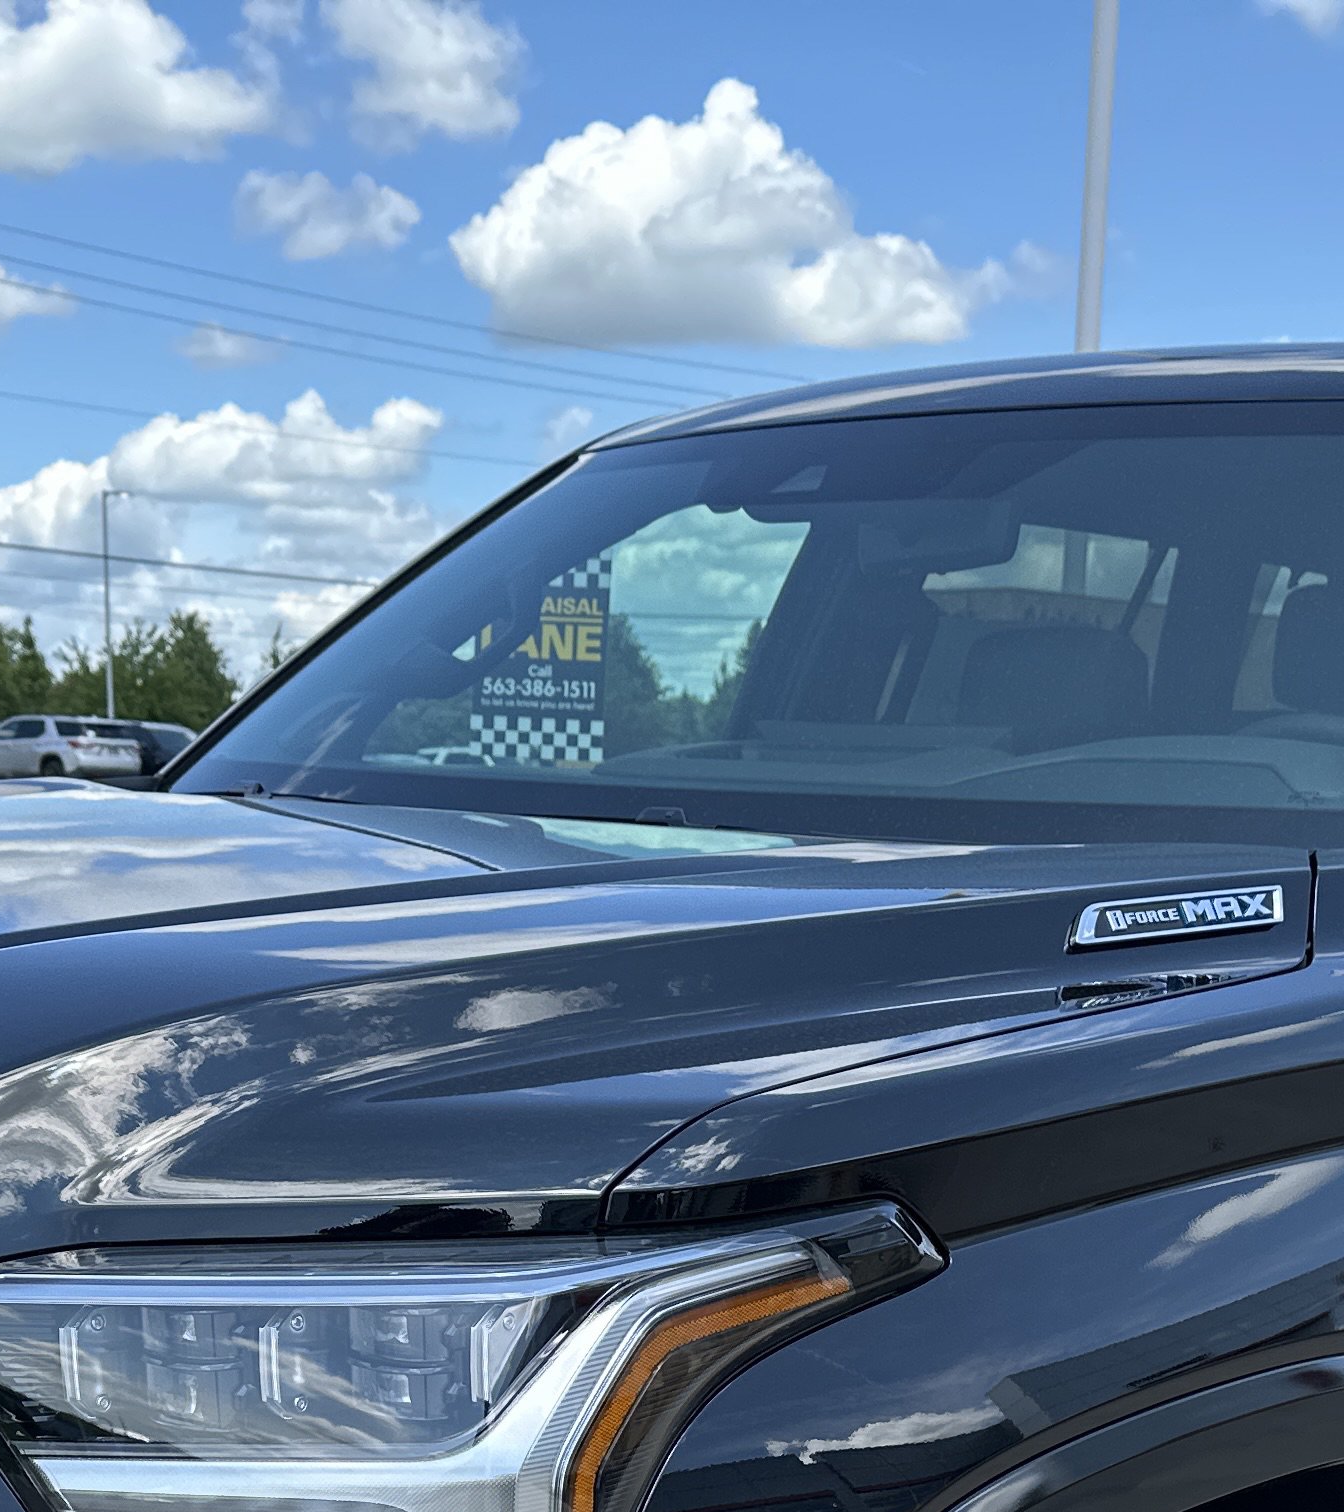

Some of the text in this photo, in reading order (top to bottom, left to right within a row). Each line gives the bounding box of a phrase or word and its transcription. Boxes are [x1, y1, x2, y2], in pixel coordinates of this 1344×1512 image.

[527, 665, 553, 677] Call
[482, 677, 596, 699] 563-386-1511
[1181, 894, 1273, 925] MAX
